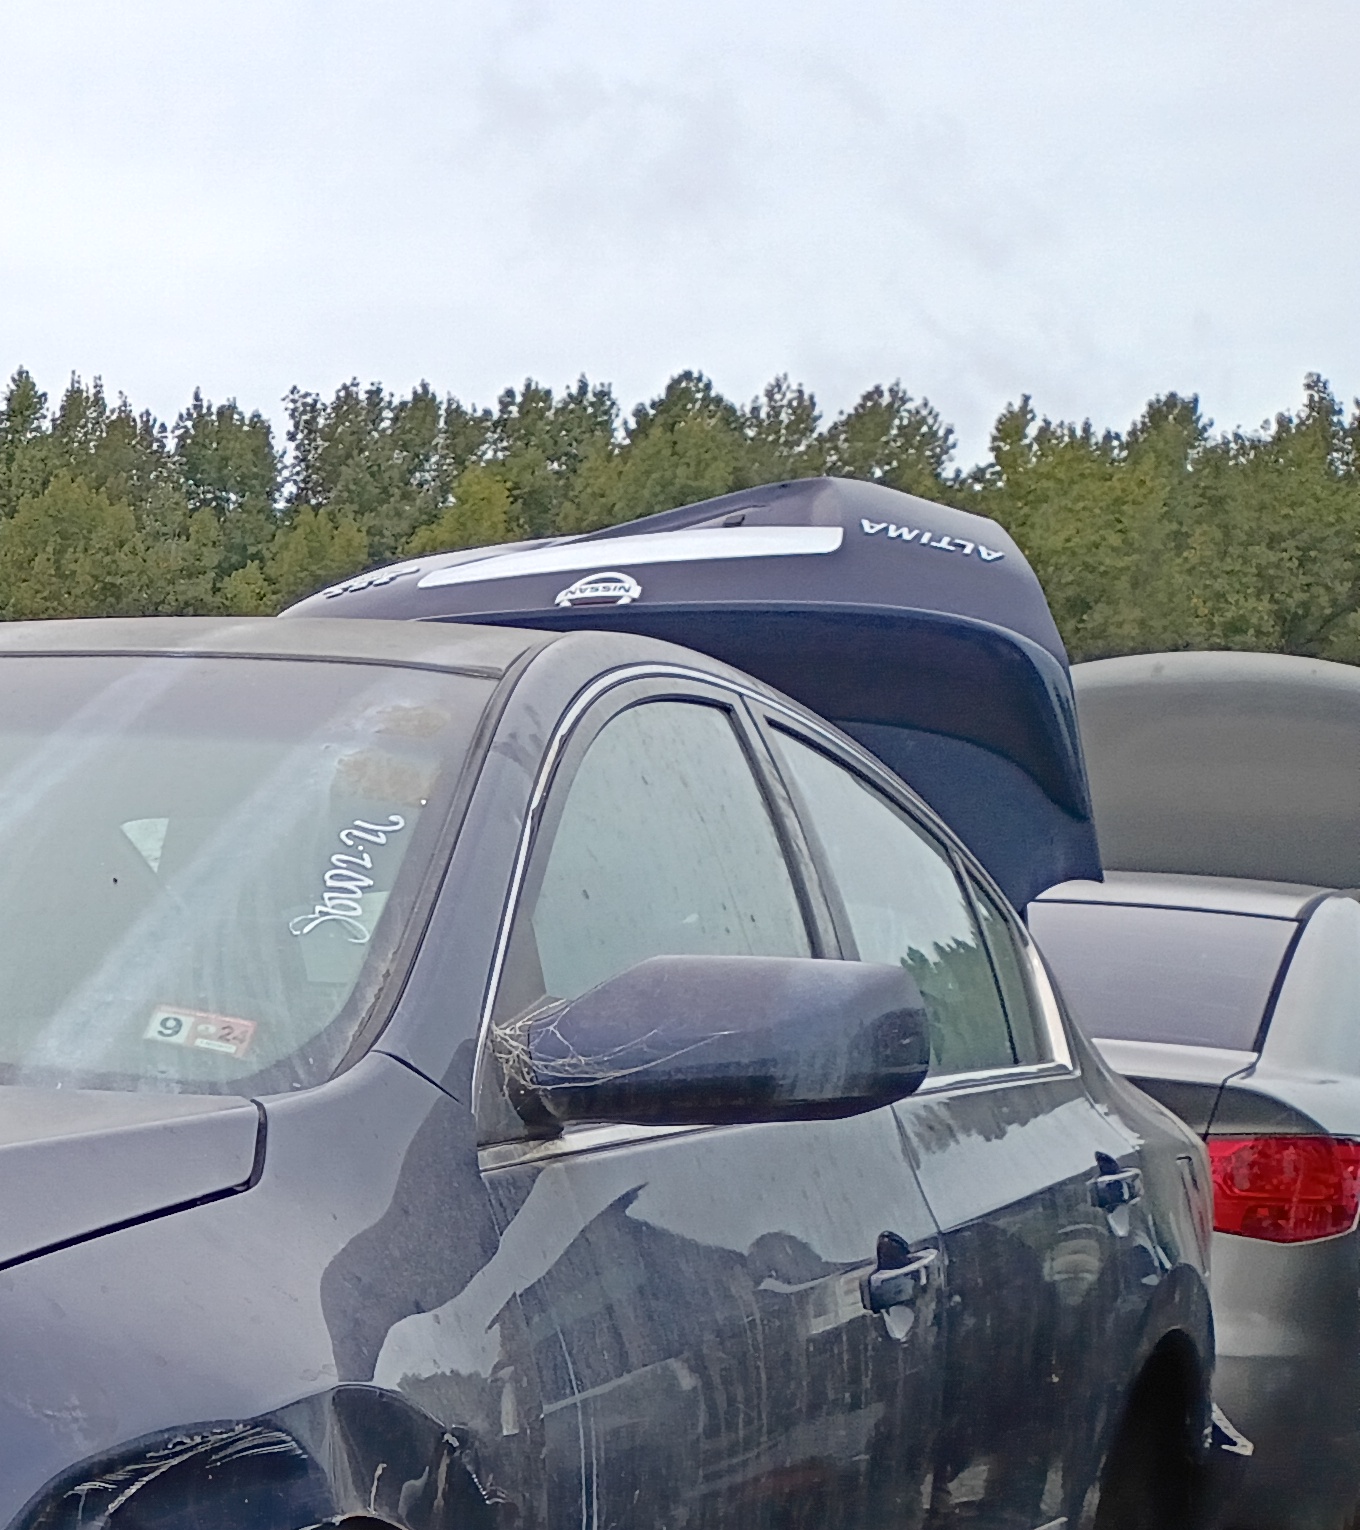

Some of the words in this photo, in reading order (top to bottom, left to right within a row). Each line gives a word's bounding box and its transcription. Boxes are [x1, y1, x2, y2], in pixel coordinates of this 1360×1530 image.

[860, 518, 1005, 561] ALTIMA
[564, 585, 632, 597] NISSAN
[156, 1015, 184, 1039] 9
